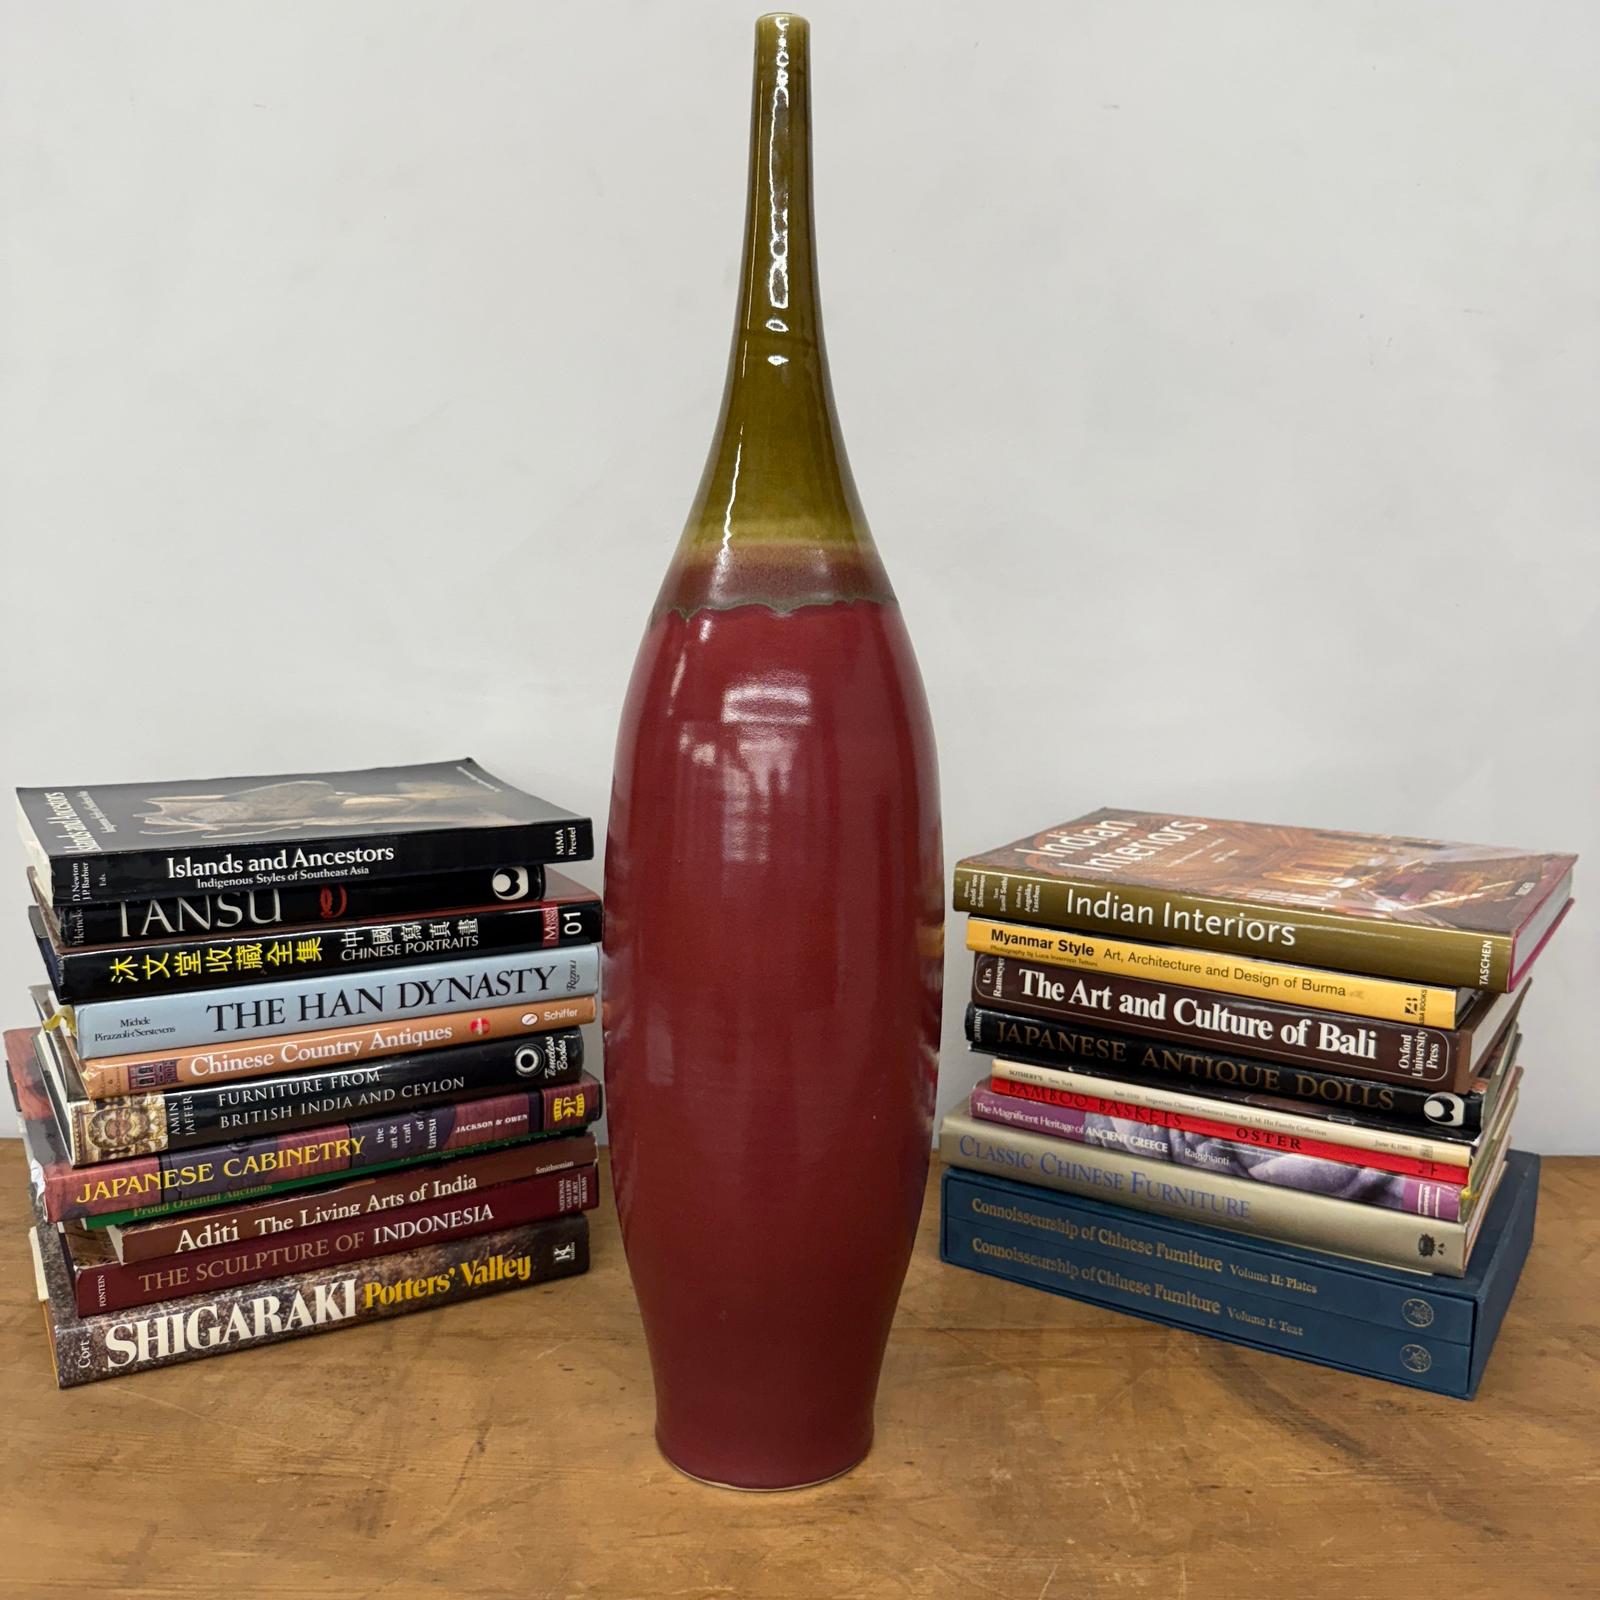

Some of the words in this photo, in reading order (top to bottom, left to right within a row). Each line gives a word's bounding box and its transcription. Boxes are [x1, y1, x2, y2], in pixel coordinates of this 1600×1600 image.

[568, 826, 576, 856] Prestel
[1014, 820, 1137, 858] Indian
[1058, 820, 1208, 873] Interiors
[72, 862, 80, 892] Newton
[82, 862, 91, 887] Barbier
[167, 853, 243, 879] Islands
[250, 850, 287, 871] and
[293, 847, 395, 868] Ancestors
[197, 875, 254, 890] Indigenous
[257, 872, 286, 886] Styles
[287, 870, 298, 881] of
[301, 868, 348, 880] Southeast
[350, 866, 369, 876] Asia
[564, 912, 582, 935] 01
[1067, 888, 1153, 925] Indian
[1164, 902, 1296, 946] Interiors
[110, 936, 322, 984] 沐文堂收藏全集
[341, 943, 401, 961] CHINESE
[405, 936, 479, 954] PORTRAITS
[991, 929, 1053, 952] Myanmar
[1058, 940, 1094, 957] Style
[1104, 949, 1124, 963] Art,
[1127, 952, 1201, 973] Architecture
[1205, 965, 1229, 978] and
[1234, 968, 1279, 987] Design
[1284, 977, 1297, 988] of
[1302, 979, 1346, 997] Burma
[1479, 940, 1492, 986] TASCHEN
[993, 958, 1005, 998] Ramseyer
[207, 998, 286, 1033] THE
[298, 985, 384, 1021] HAN
[397, 965, 557, 1010] DYNASTY
[544, 1007, 578, 1021] Schiffer
[1019, 969, 1065, 1001] The
[1070, 979, 1112, 1010] Art
[1118, 993, 1166, 1021] and
[1173, 998, 1274, 1040] Culture
[1281, 1020, 1311, 1047] of
[1316, 1022, 1377, 1060] Bali
[190, 1052, 274, 1077] Chinese
[280, 1039, 362, 1063] Country
[369, 1025, 453, 1053] Antiques
[558, 1040, 568, 1071] Books
[997, 1021, 1127, 1063] JAPANESE
[1142, 1048, 1280, 1090] ANTIQUE
[1296, 1074, 1394, 1111] DOLLS
[1398, 1035, 1412, 1069] Oxford
[1412, 1030, 1428, 1077] University
[1426, 1043, 1439, 1069] Press
[218, 1079, 322, 1107] FURNITURE
[331, 1071, 380, 1089] FROM
[221, 1105, 292, 1129] BRITISH
[302, 1097, 353, 1115] INDIA
[359, 1088, 395, 1105] AND
[401, 1076, 465, 1098] CEYLON
[169, 1101, 180, 1135] AMIN
[186, 1095, 196, 1135] JAFFER
[391, 1125, 398, 1135] &
[416, 1120, 424, 1130] of
[429, 1118, 437, 1149] tansu
[455, 1121, 493, 1134] JACKSON
[505, 1114, 528, 1124] OWEN
[976, 1102, 993, 1114] The
[992, 1106, 1039, 1125] Magnificent
[1040, 1116, 1075, 1134] Heritage
[1075, 1123, 1084, 1133] of
[1084, 1126, 1129, 1145] ANCIENT
[1130, 1134, 1168, 1152] GREECE
[1008, 1080, 1088, 1108] BAMBOO
[1099, 1100, 1182, 1126] BASKETS
[1236, 1128, 1301, 1149] OSTER
[77, 1164, 214, 1203] JAPANESE
[223, 1136, 365, 1177] CABINETRY
[536, 1160, 574, 1175] Smithsonian
[960, 1135, 1032, 1169] CLASSIC
[1040, 1151, 1123, 1192] CHINESE
[1131, 1170, 1250, 1218] FURNITURE
[133, 1203, 169, 1218] Proud
[172, 1193, 222, 1209] Oriental
[225, 1183, 273, 1199] Auctions
[175, 1219, 240, 1253] Aditi
[255, 1217, 293, 1236] The
[300, 1203, 361, 1225] Living
[366, 1195, 404, 1213] Arts
[410, 1184, 428, 1202] of
[433, 1175, 477, 1195] India
[139, 1268, 190, 1292] THE
[196, 1239, 329, 1281] SCULPTURE
[336, 1232, 365, 1251] OF
[373, 1204, 494, 1245] INDONESIA
[972, 1198, 1078, 1238] Connoisseurship
[1081, 1225, 1096, 1240] of
[1098, 1229, 1152, 1257] Chinese
[1156, 1243, 1222, 1272] Furniture
[1230, 1264, 1268, 1284] Volume
[1287, 1276, 1318, 1295] Plates
[972, 1238, 1079, 1280] Connoisseurship
[1081, 1265, 1098, 1280] of
[1097, 1270, 1150, 1296] Chinese
[1154, 1284, 1221, 1314] Furniture
[1227, 1307, 1266, 1327] Volume
[1279, 1320, 1304, 1336] Text
[105, 1278, 357, 1368] SHIGARAKI
[364, 1268, 454, 1309] Potters'
[460, 1254, 531, 1287] Valley
[78, 1340, 90, 1368] Cort
